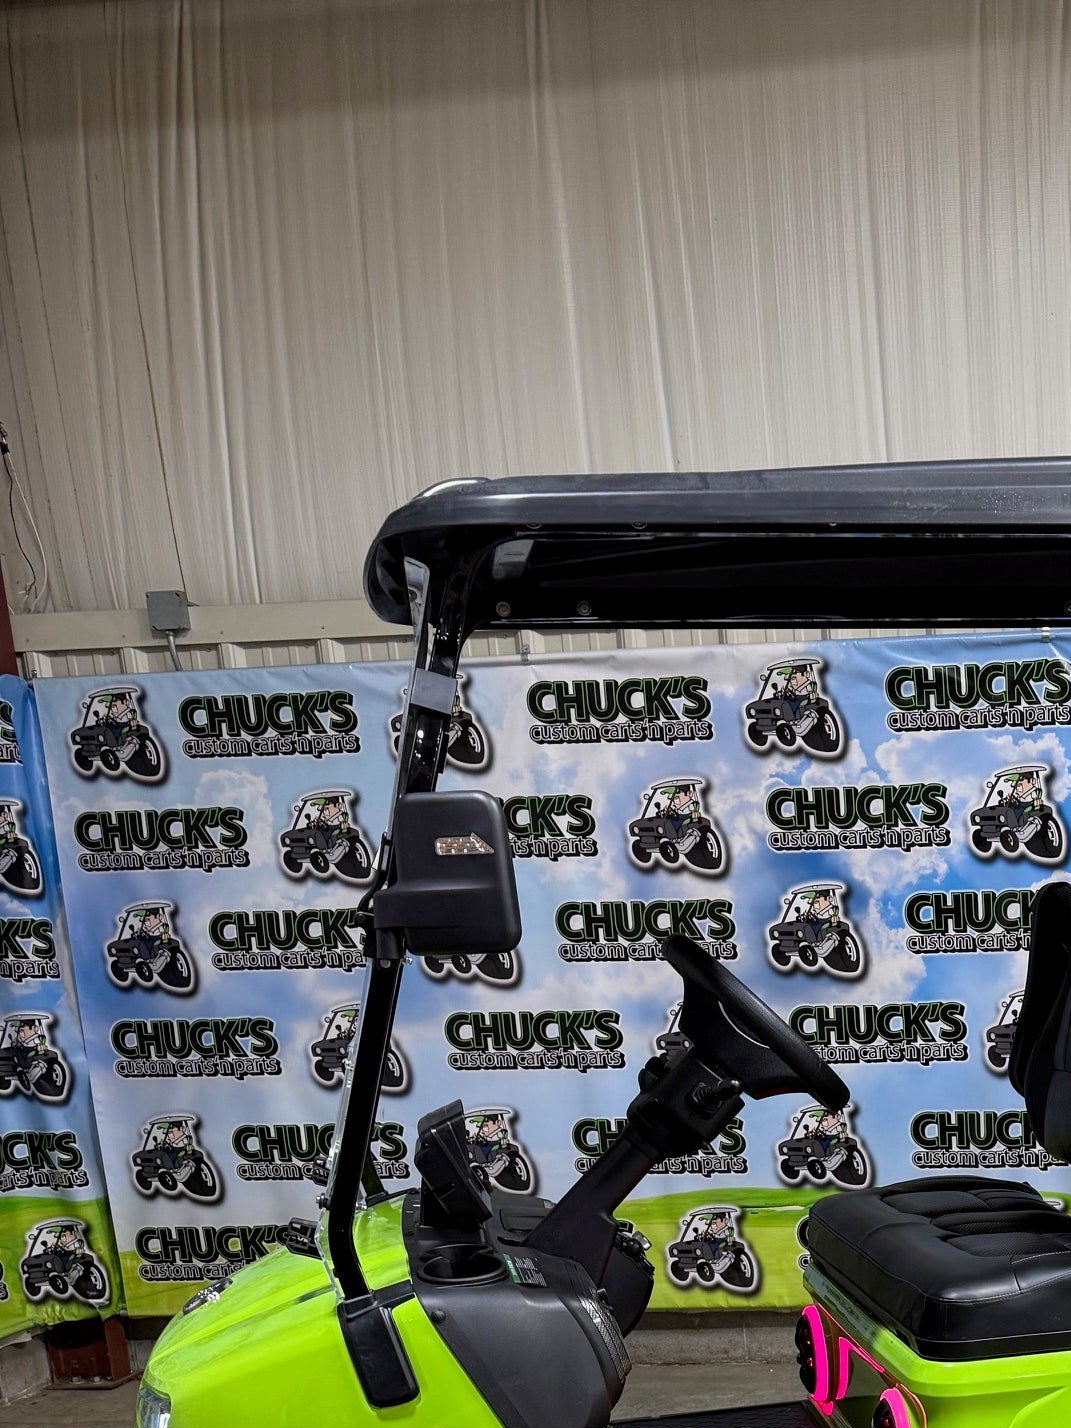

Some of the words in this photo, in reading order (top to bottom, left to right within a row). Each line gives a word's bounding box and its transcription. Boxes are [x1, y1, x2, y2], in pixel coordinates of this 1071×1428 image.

[527, 676, 711, 724] CHUCK'S
[178, 691, 358, 739] CHUCK'S
[888, 708, 956, 728] custom
[1024, 704, 1070, 728] parts
[530, 722, 597, 741] custom
[664, 720, 709, 742] parts
[183, 737, 248, 755] custom
[312, 733, 357, 756] parts
[766, 783, 949, 831] CHUCK'S
[74, 807, 247, 852] CHUCK'S
[768, 830, 835, 848] custom
[901, 826, 947, 849] parts
[547, 837, 594, 858] parts
[78, 851, 140, 868] custom
[202, 848, 246, 870] parts
[559, 942, 624, 959] custom
[907, 933, 973, 950] custom
[11, 959, 59, 979] parts
[212, 951, 277, 968] custom
[445, 1011, 623, 1051] CHUCK'S
[789, 1002, 967, 1045] CHUCK'S
[111, 1018, 278, 1059] CHUCK'S
[448, 1051, 513, 1067] custom
[578, 1050, 621, 1070] parts
[920, 1042, 964, 1063] parts
[115, 1058, 173, 1075] custom
[234, 1057, 278, 1077] parts
[701, 1156, 744, 1175] parts
[912, 1150, 975, 1166] custom
[237, 1162, 299, 1178] custom
[139, 1264, 199, 1279] custom
